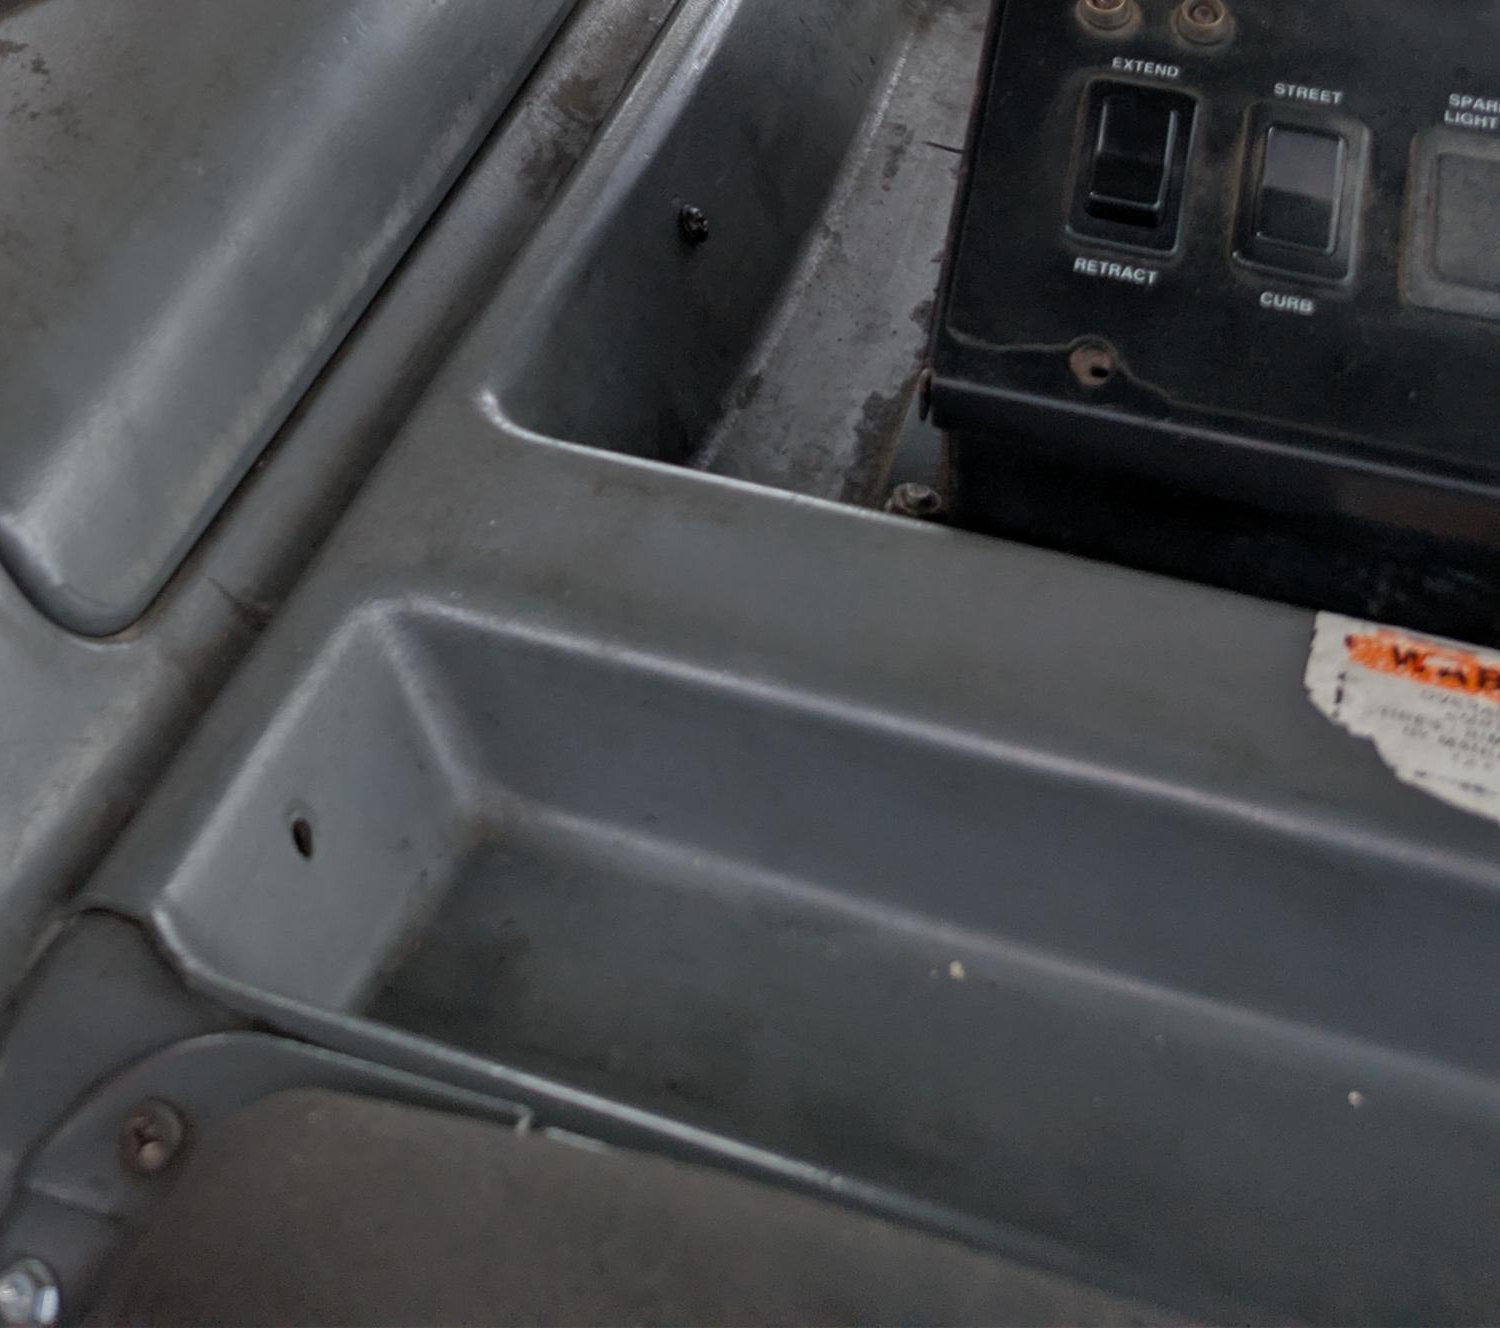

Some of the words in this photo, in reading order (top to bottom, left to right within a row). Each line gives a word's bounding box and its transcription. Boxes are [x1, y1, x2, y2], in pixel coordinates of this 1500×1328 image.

[1112, 56, 1180, 78] EXTEND
[1273, 82, 1343, 104] STREET
[1449, 93, 1500, 114] SPAR
[1444, 109, 1499, 129] LIGHT
[1073, 257, 1158, 287] RETRACT
[1259, 291, 1315, 315] CURB
